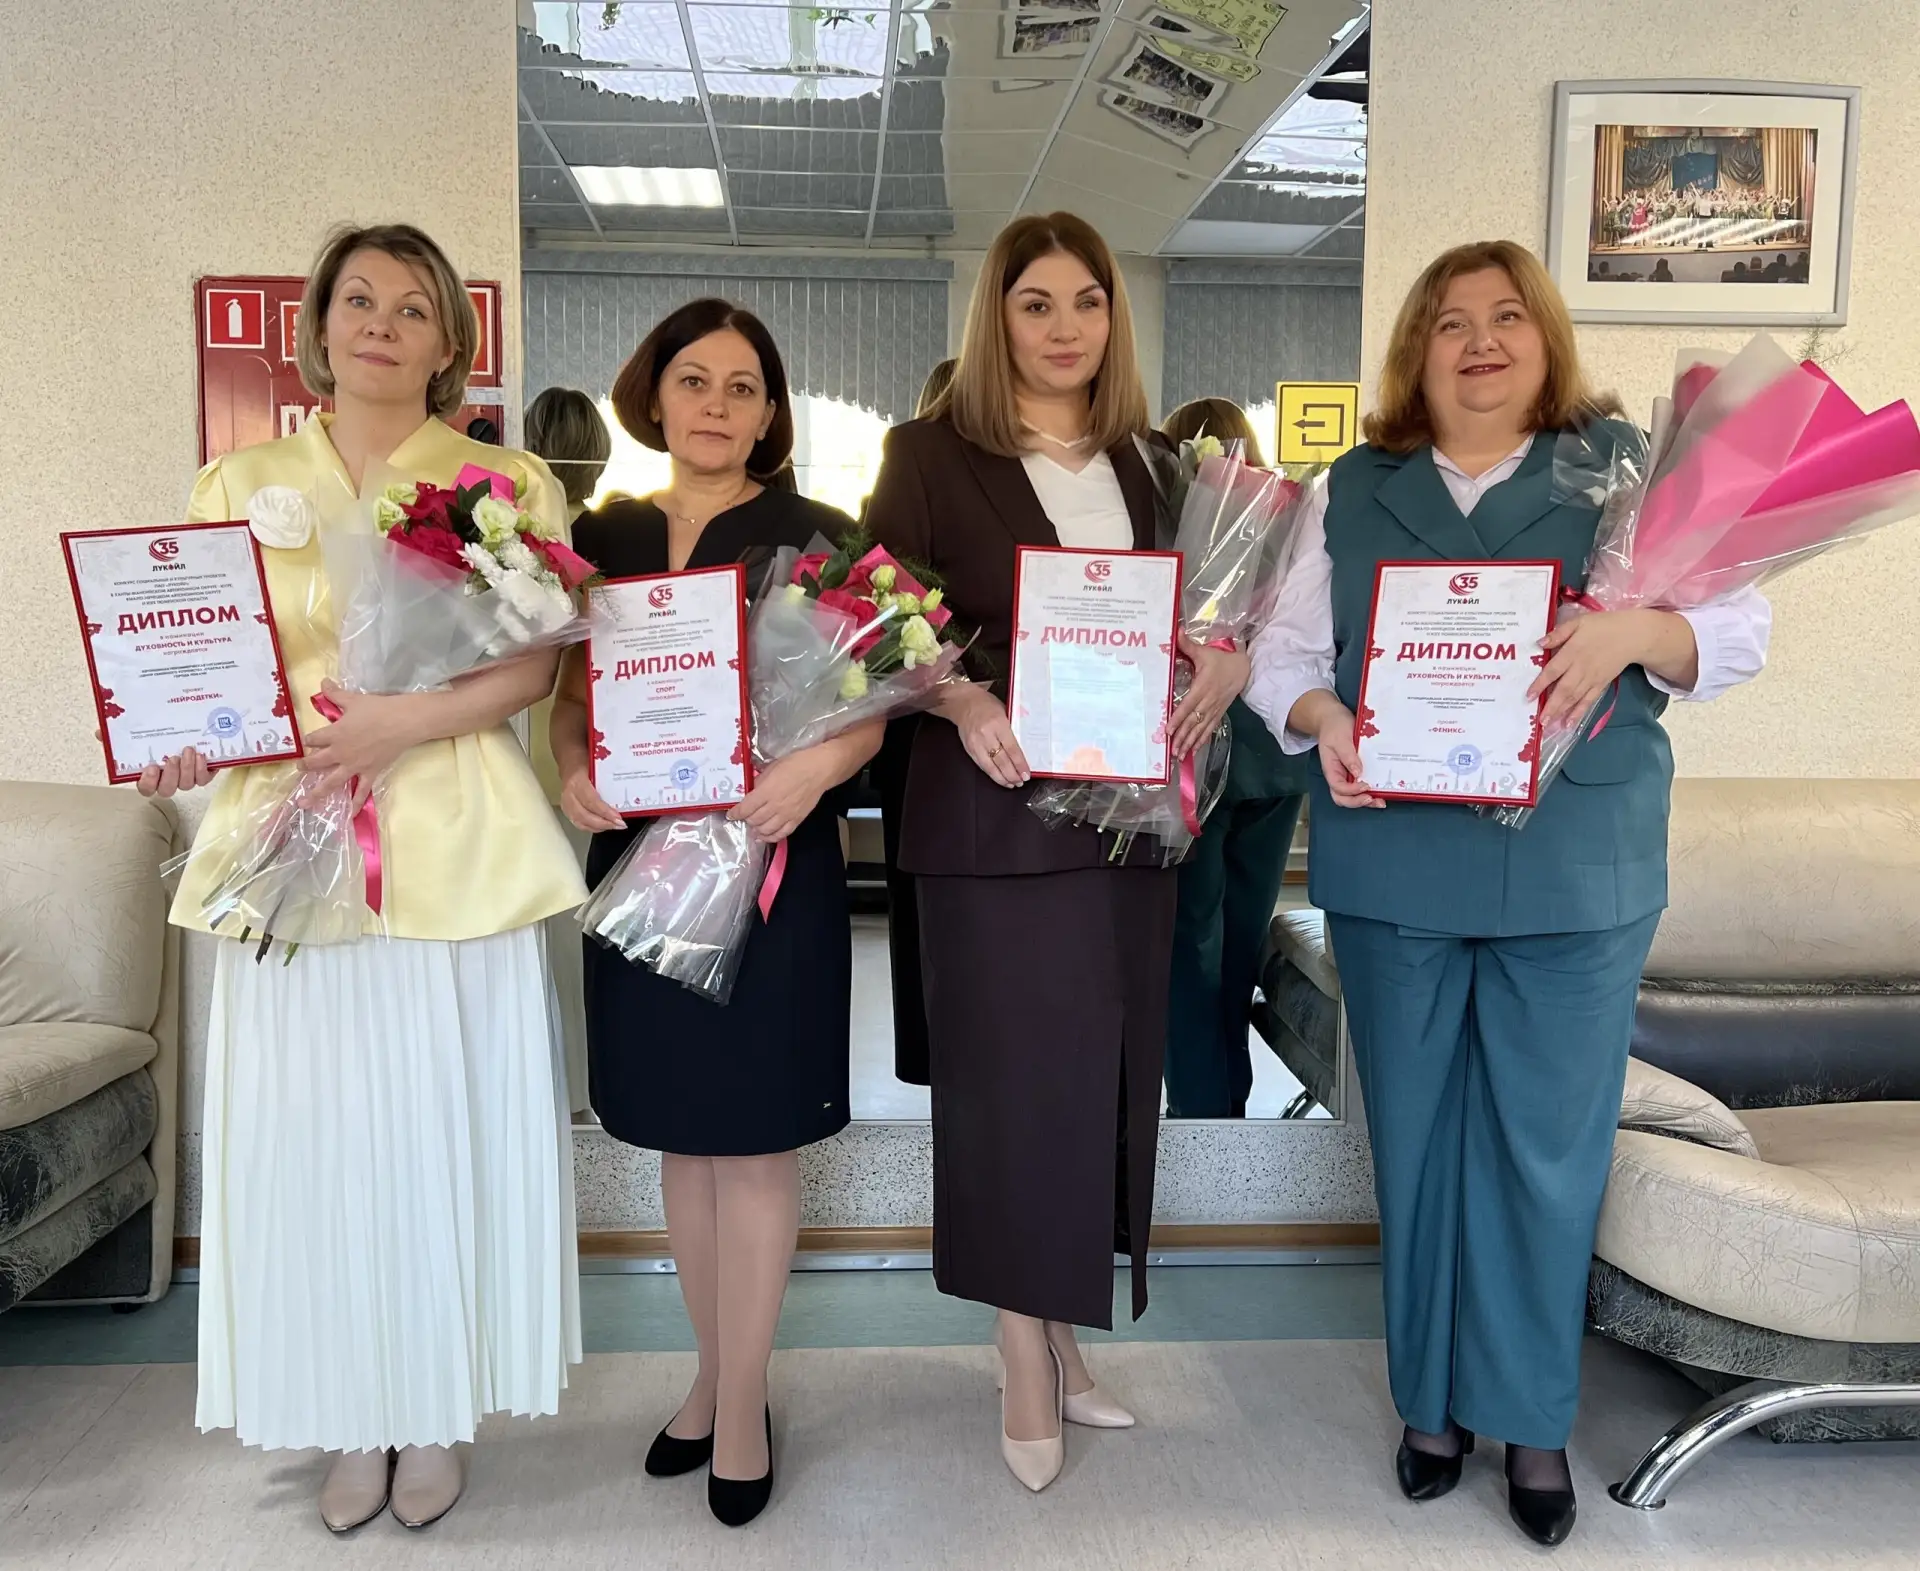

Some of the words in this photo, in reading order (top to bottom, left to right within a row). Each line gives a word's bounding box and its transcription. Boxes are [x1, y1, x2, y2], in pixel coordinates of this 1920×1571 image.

[158, 541, 179, 555] 35
[1093, 564, 1111, 577] 35
[1459, 576, 1479, 589] 35
[656, 587, 673, 601] 35
[117, 605, 240, 635] ДИПЛОМ
[1040, 625, 1147, 648] ДИПЛОМ
[135, 641, 186, 652] ДУХОВНОСТЬ
[194, 636, 232, 646] КУЛЬТУРА
[1396, 642, 1516, 662] ДИПЛОМ
[615, 650, 716, 681] ДИПЛОМ
[167, 692, 223, 704] «НЕЙРОДЕТКИ»
[632, 749, 674, 757] ТЕХНОЛОГИИ
